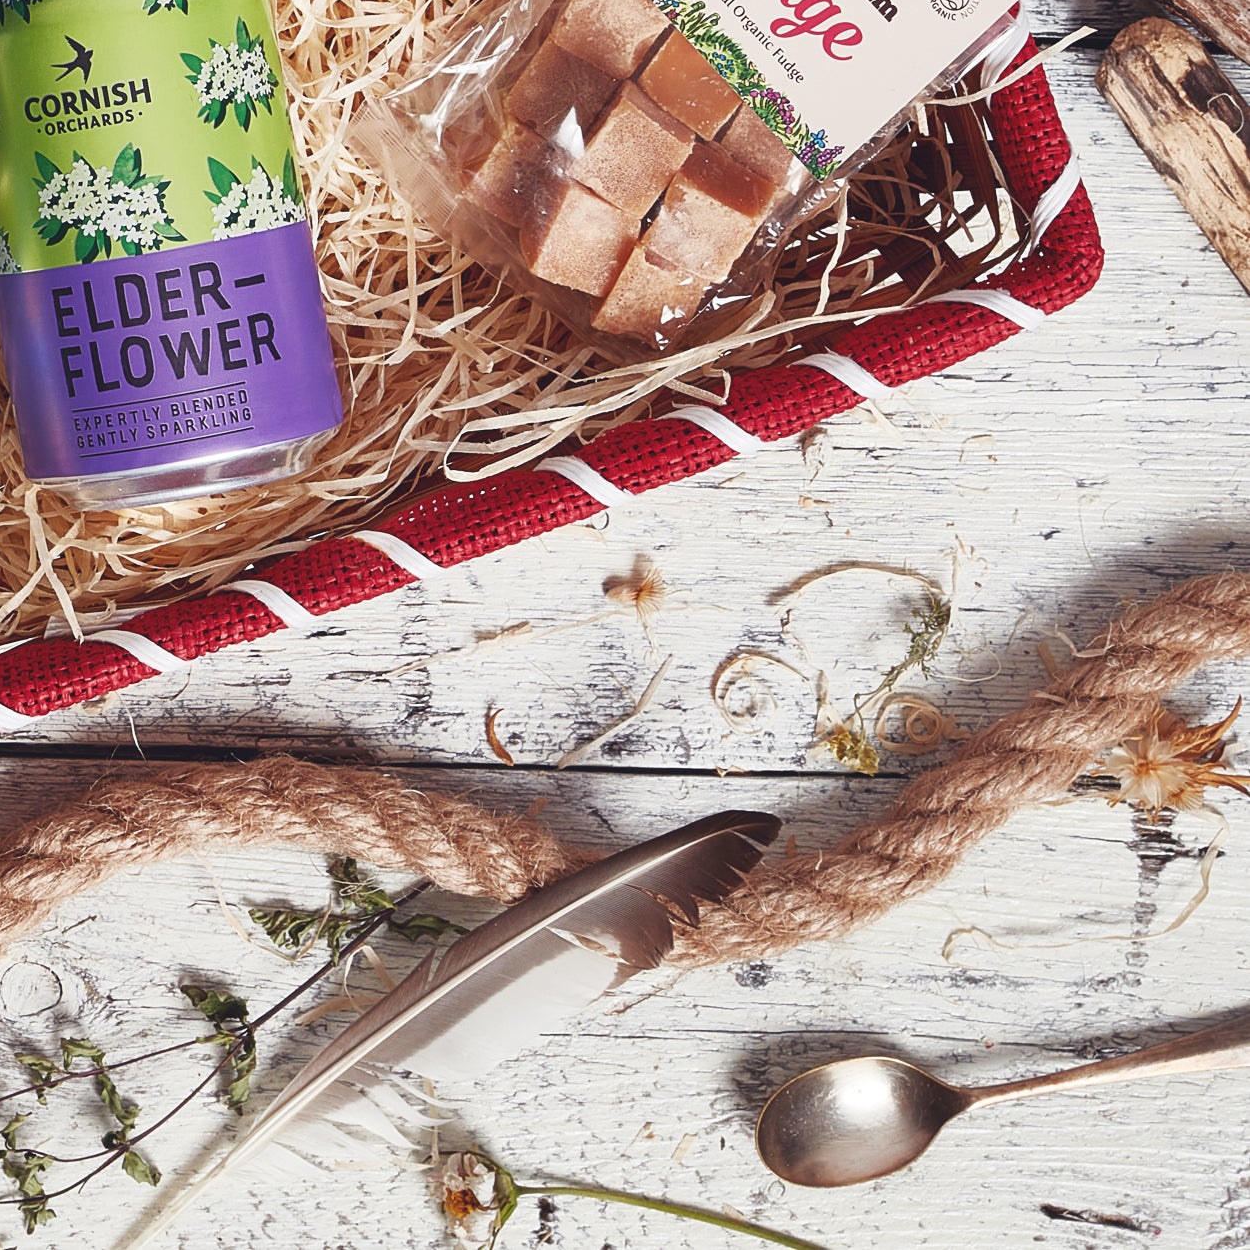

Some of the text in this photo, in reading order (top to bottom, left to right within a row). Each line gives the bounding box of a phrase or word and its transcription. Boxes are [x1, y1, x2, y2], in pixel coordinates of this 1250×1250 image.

[733, 5, 774, 51] Organic
[772, 46, 805, 85] Fudge
[24, 78, 152, 123] CORNISH
[51, 261, 266, 338] ELDER-
[60, 312, 282, 398] FLOWER
[73, 389, 249, 432] EXPERTLY BLENDED
[77, 407, 252, 449] GENTLY SPARKLING
